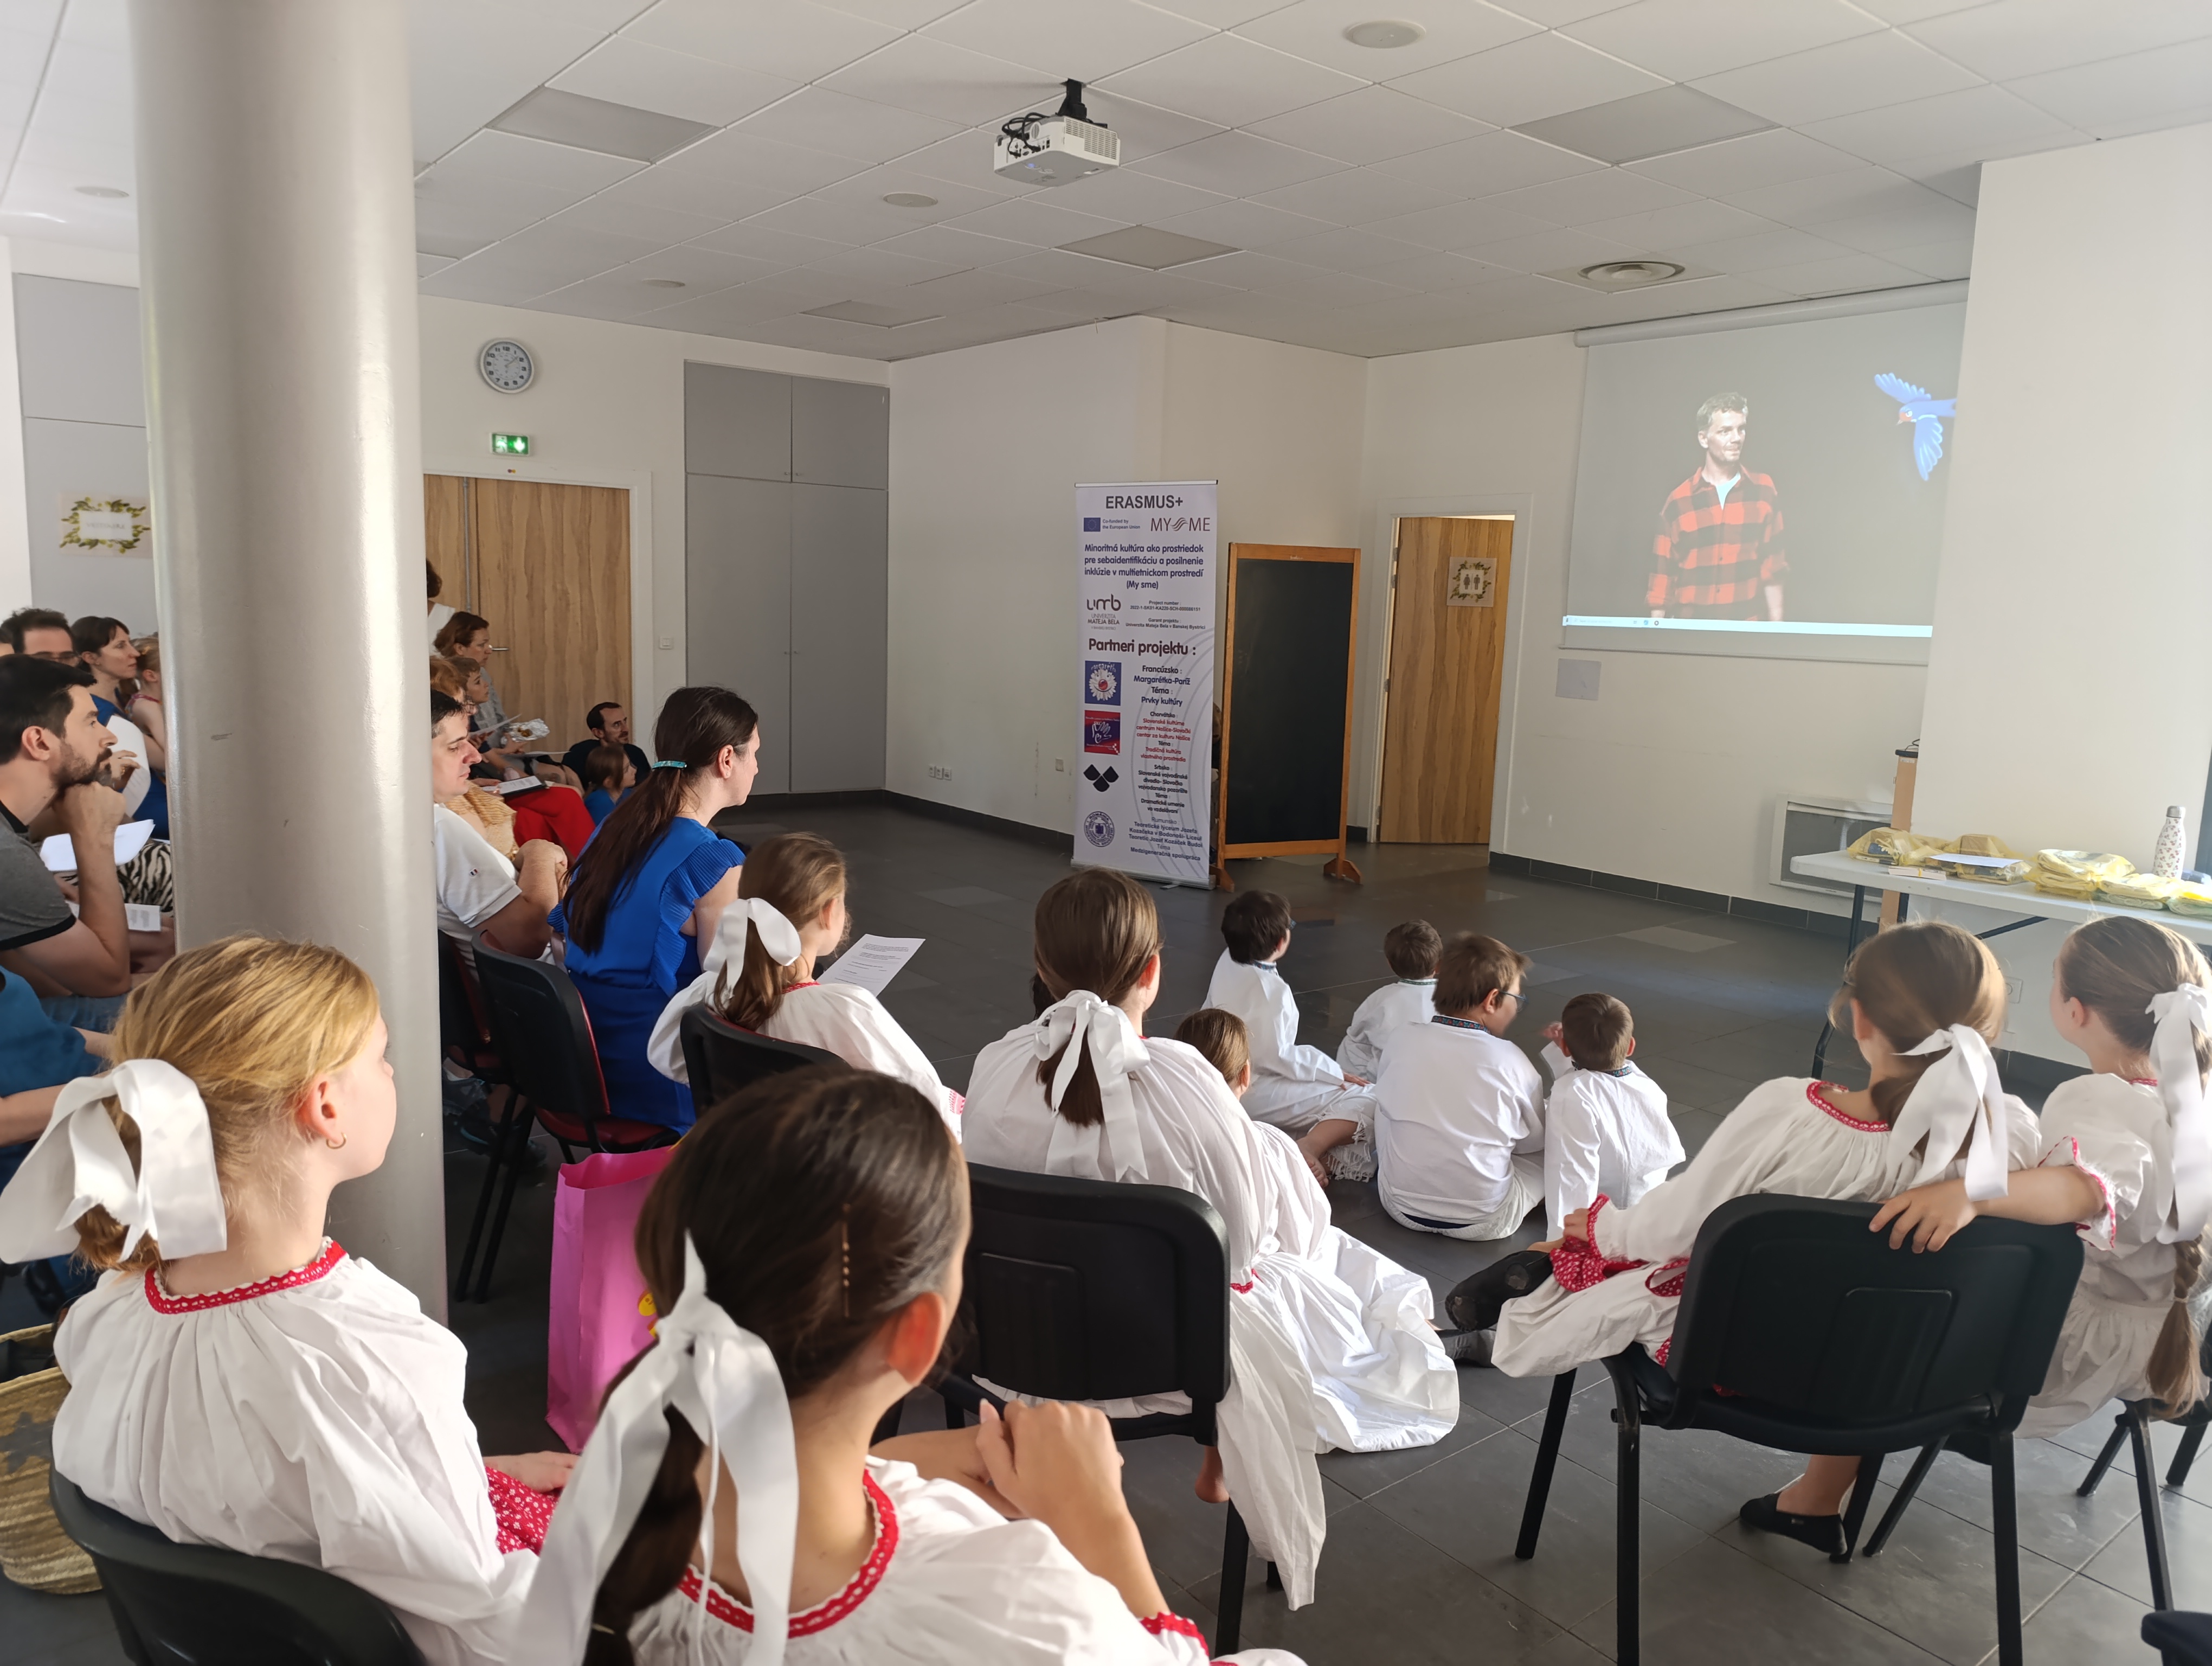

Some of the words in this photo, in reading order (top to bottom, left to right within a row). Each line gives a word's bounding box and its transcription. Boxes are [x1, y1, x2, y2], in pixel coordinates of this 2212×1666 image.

[1105, 495, 1183, 509] ERASMUS+
[1150, 518, 1172, 531] MY
[1189, 517, 1210, 531] ME
[1084, 544, 1118, 552] Minoritná
[1120, 544, 1144, 552] kultúra
[1147, 544, 1160, 552] ako
[1162, 544, 1204, 554] prostriedok
[1097, 556, 1157, 565] sebaidentifikáciu
[1166, 556, 1203, 566] posilnenie
[1084, 567, 1110, 575] inklúzie
[1118, 568, 1168, 576] multietnickom
[1170, 569, 1204, 579] prostredí
[1126, 580, 1139, 589] (My
[1141, 581, 1159, 589] sme)
[1089, 638, 1135, 652] Partneri
[1138, 640, 1188, 657] projektu
[1142, 665, 1179, 674] Francúzsko
[1151, 686, 1169, 694] Téma
[1141, 696, 1159, 706] Prvky
[1161, 697, 1183, 707] kultúry
